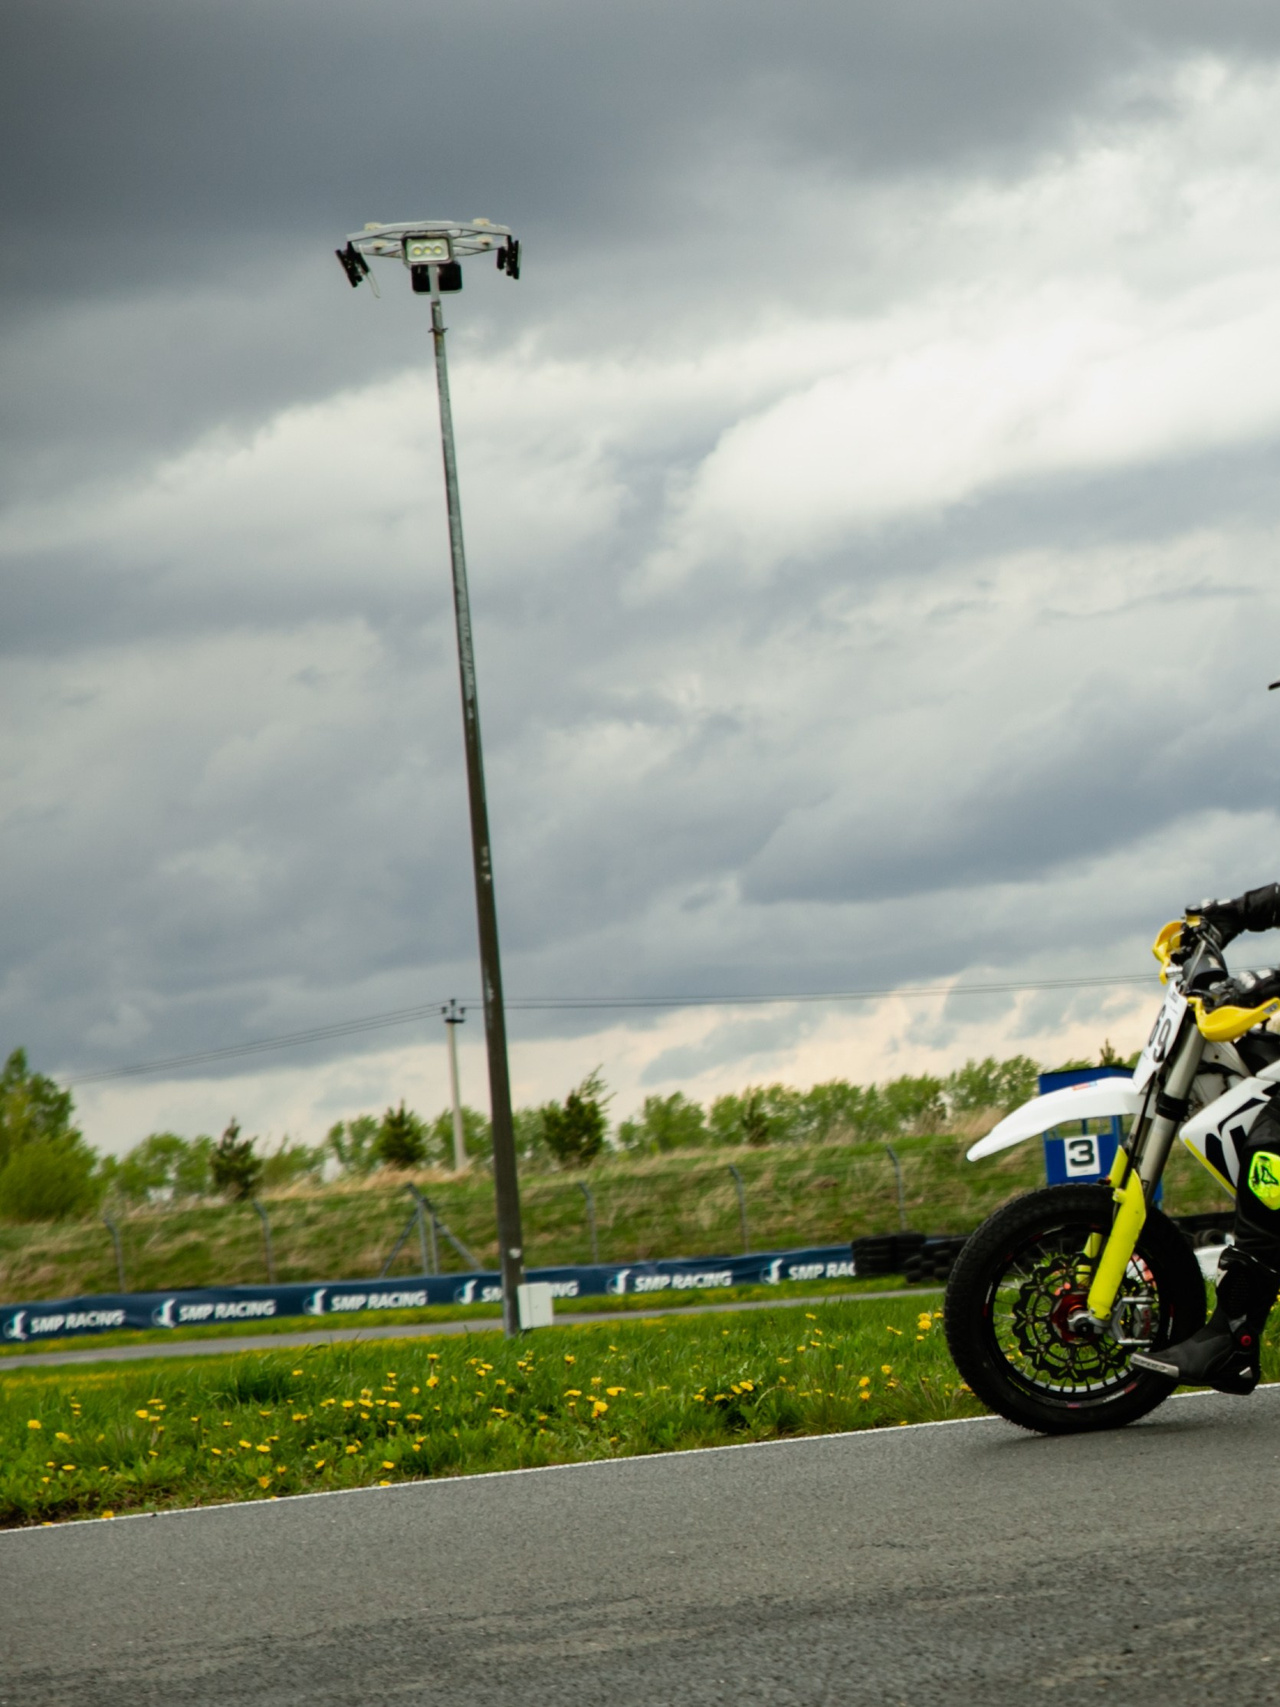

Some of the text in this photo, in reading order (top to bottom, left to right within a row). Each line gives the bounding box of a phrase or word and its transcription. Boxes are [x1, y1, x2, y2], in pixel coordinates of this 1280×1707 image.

[1068, 1139, 1095, 1168] 3
[634, 1269, 732, 1292] SMP RACING
[788, 1261, 856, 1280] SMP RAC
[179, 1300, 276, 1322] SMP RACING
[330, 1290, 428, 1312] SMP RACING
[30, 1309, 126, 1334] SMP RACING
